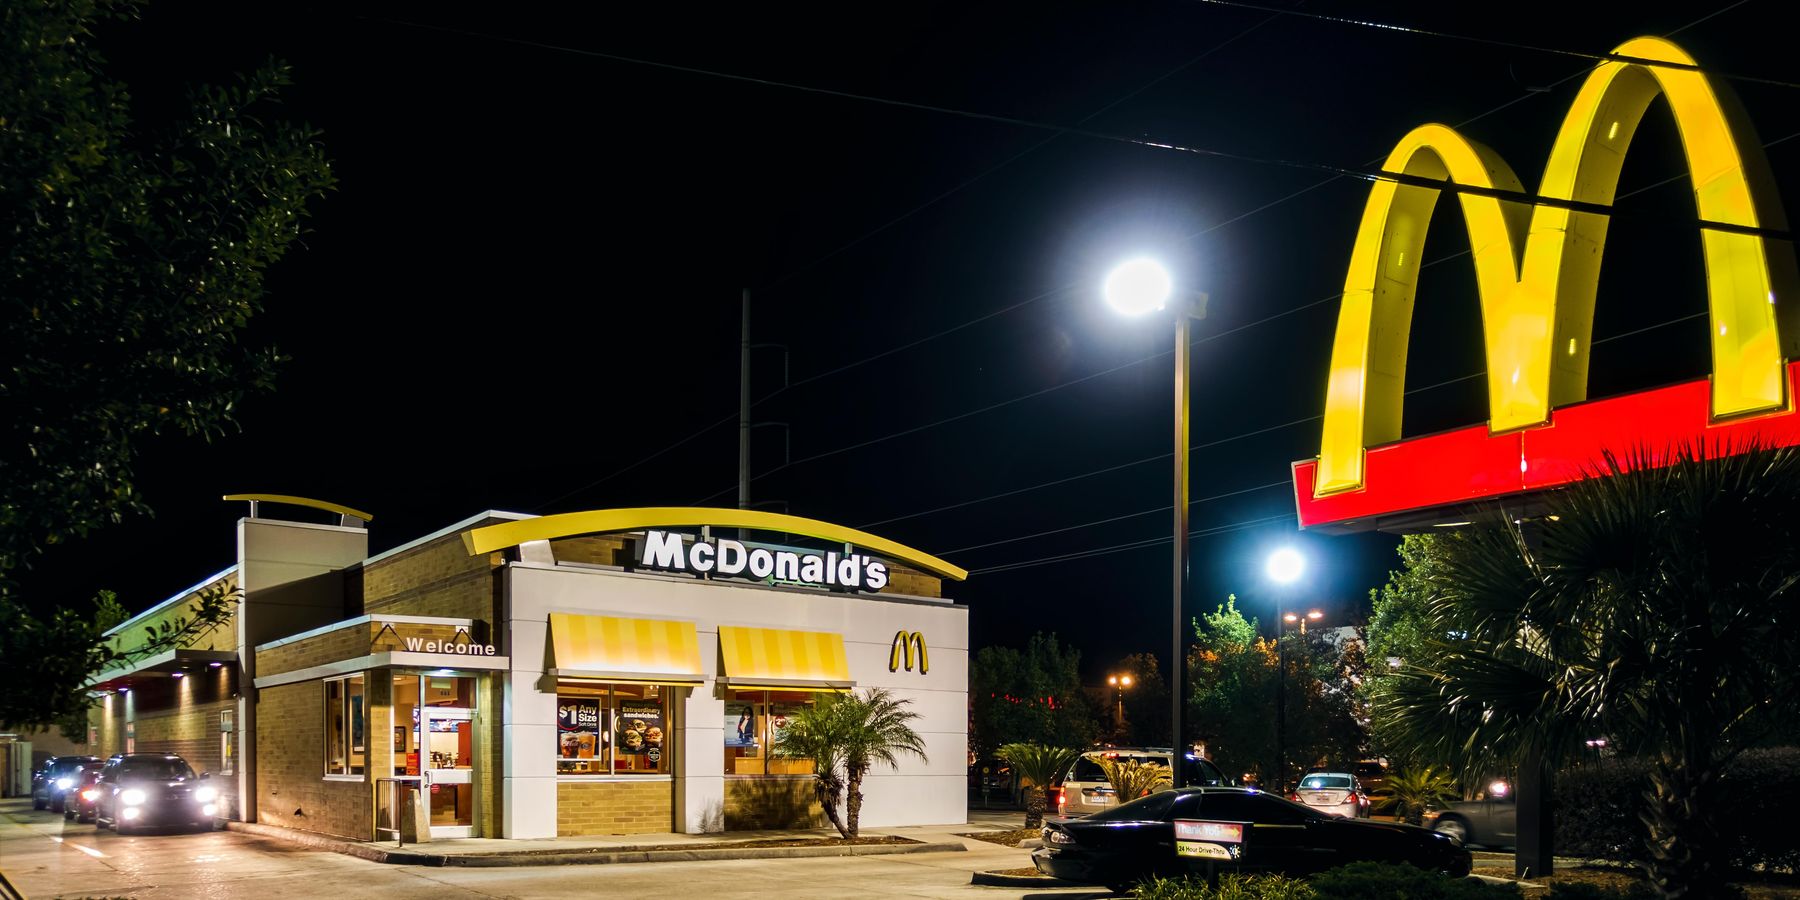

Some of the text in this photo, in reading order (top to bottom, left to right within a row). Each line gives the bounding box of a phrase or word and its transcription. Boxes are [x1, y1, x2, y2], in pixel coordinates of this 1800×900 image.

[642, 530, 888, 589] McDonald's
[406, 637, 496, 656] Welcome
[559, 705, 577, 724] $1
[578, 704, 597, 715] Any
[578, 714, 597, 722] Size
[1177, 823, 1202, 835] Thank
[1199, 847, 1225, 855] Drive-Thru
